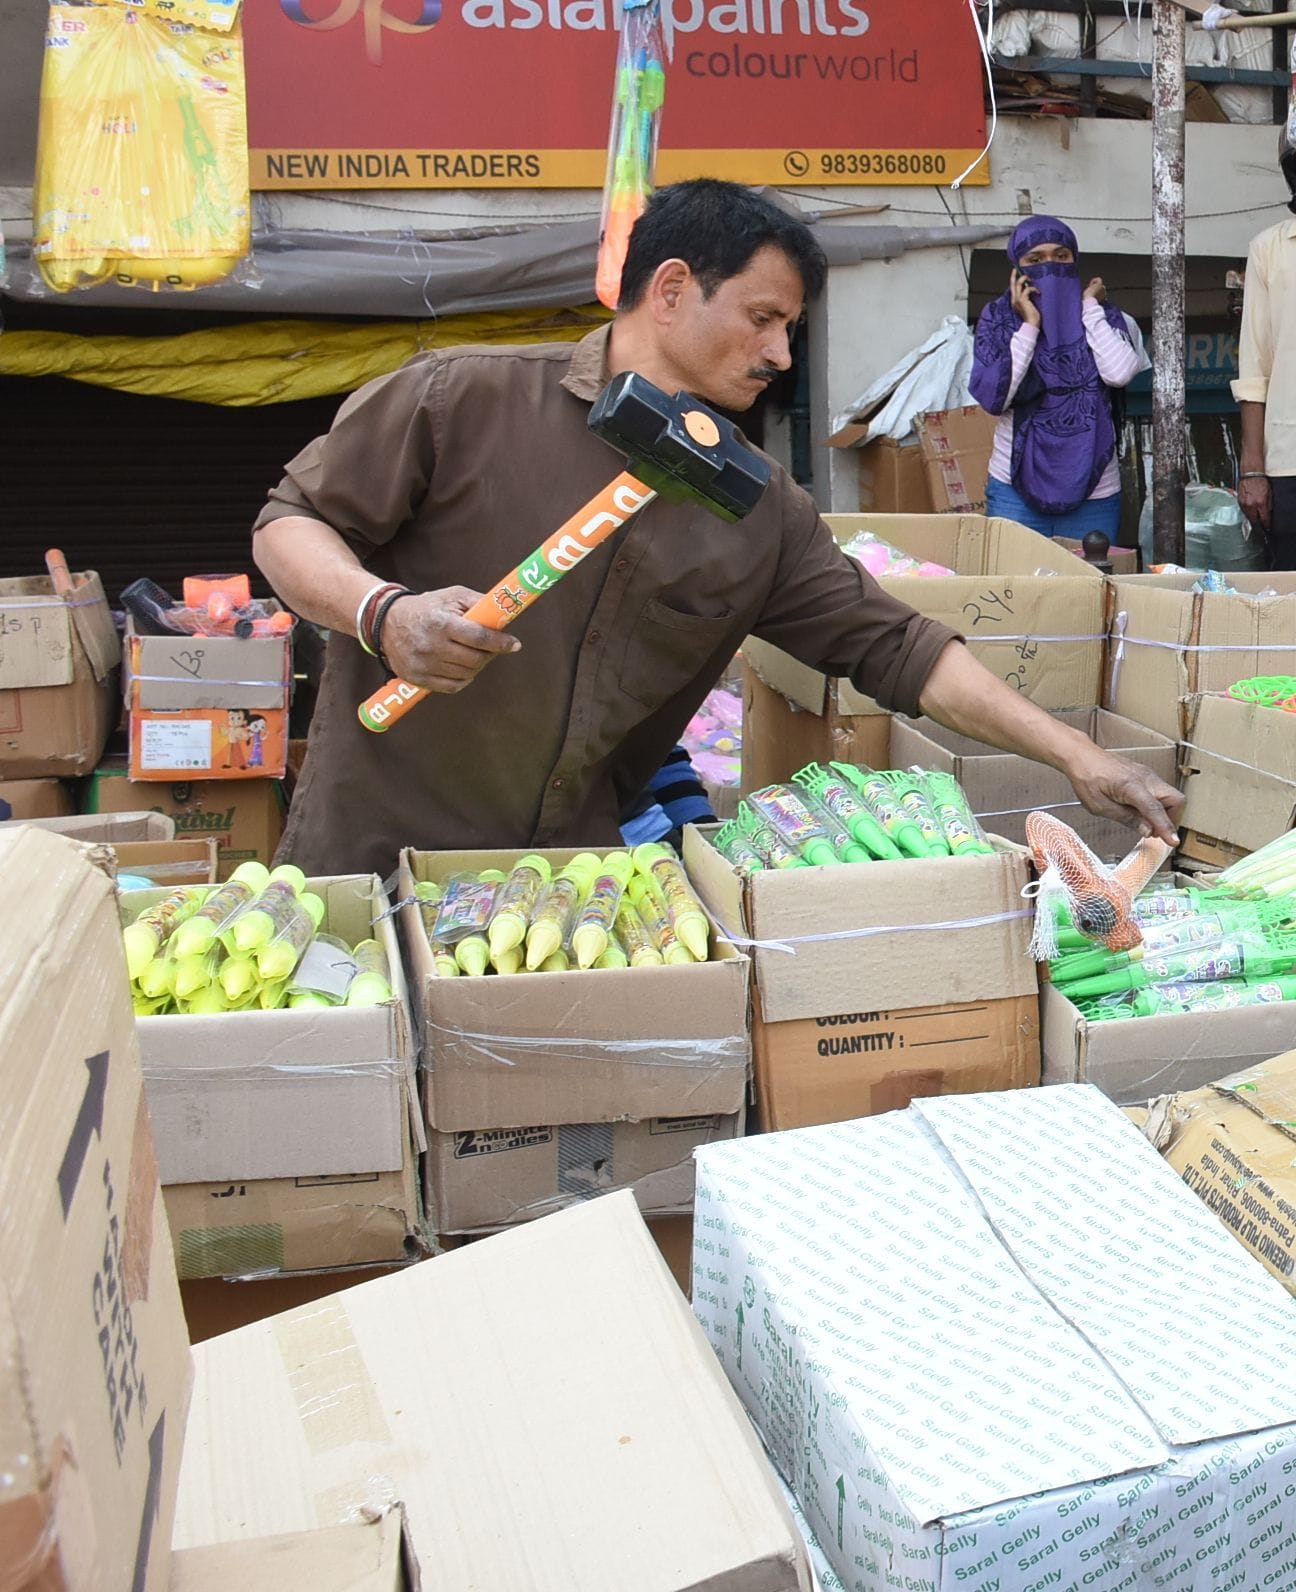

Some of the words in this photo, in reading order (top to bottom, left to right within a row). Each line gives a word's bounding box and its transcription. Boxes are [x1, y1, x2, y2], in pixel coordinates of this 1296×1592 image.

[687, 44, 806, 79] colour
[817, 48, 918, 83] world
[102, 122, 137, 135] HOLI
[267, 154, 329, 179] NEW
[338, 153, 410, 178] INDIA
[417, 153, 540, 178] TRADERS
[820, 156, 946, 175] 9839368080
[548, 485, 659, 571] BJP
[817, 1031, 894, 1057] QUANTITY
[456, 1126, 549, 1156] 2-Minute
[479, 1133, 549, 1153] noodles
[1182, 1163, 1199, 1187] LTD.
[1200, 1153, 1220, 1178] India
[1197, 1176, 1212, 1203] PVT.
[1207, 1189, 1244, 1233] PRODUCTS
[1240, 1188, 1295, 1248] Patna-800006,
[1241, 1220, 1260, 1248] PULP
[1258, 1234, 1295, 1277] GREENKO
[93, 1271, 126, 1468] CARE
[1175, 1470, 1210, 1497] Saral
[1229, 1452, 1264, 1484] Saral
[1057, 1486, 1097, 1518] Saral
[1194, 1507, 1229, 1538] Saral
[1233, 1482, 1266, 1511] Gelly
[1247, 1494, 1281, 1525] Saral
[1135, 1518, 1174, 1548] Saral
[1178, 1492, 1213, 1520] Gelly
[934, 1532, 977, 1556] Gelly
[955, 1551, 998, 1580] Saral
[1002, 1525, 1040, 1554] Gelly
[1018, 1539, 1058, 1571] Saral
[1062, 1514, 1099, 1542] Gelly
[1080, 1531, 1120, 1561] Saral
[1211, 1548, 1246, 1578] Saral
[1249, 1521, 1282, 1549] Gelly
[1262, 1533, 1296, 1562] Saral
[1083, 1553, 1120, 1584] Gelly
[1141, 1546, 1176, 1573] Gelly
[1155, 1558, 1192, 1586] Saral
[1196, 1533, 1230, 1560] Gelly
